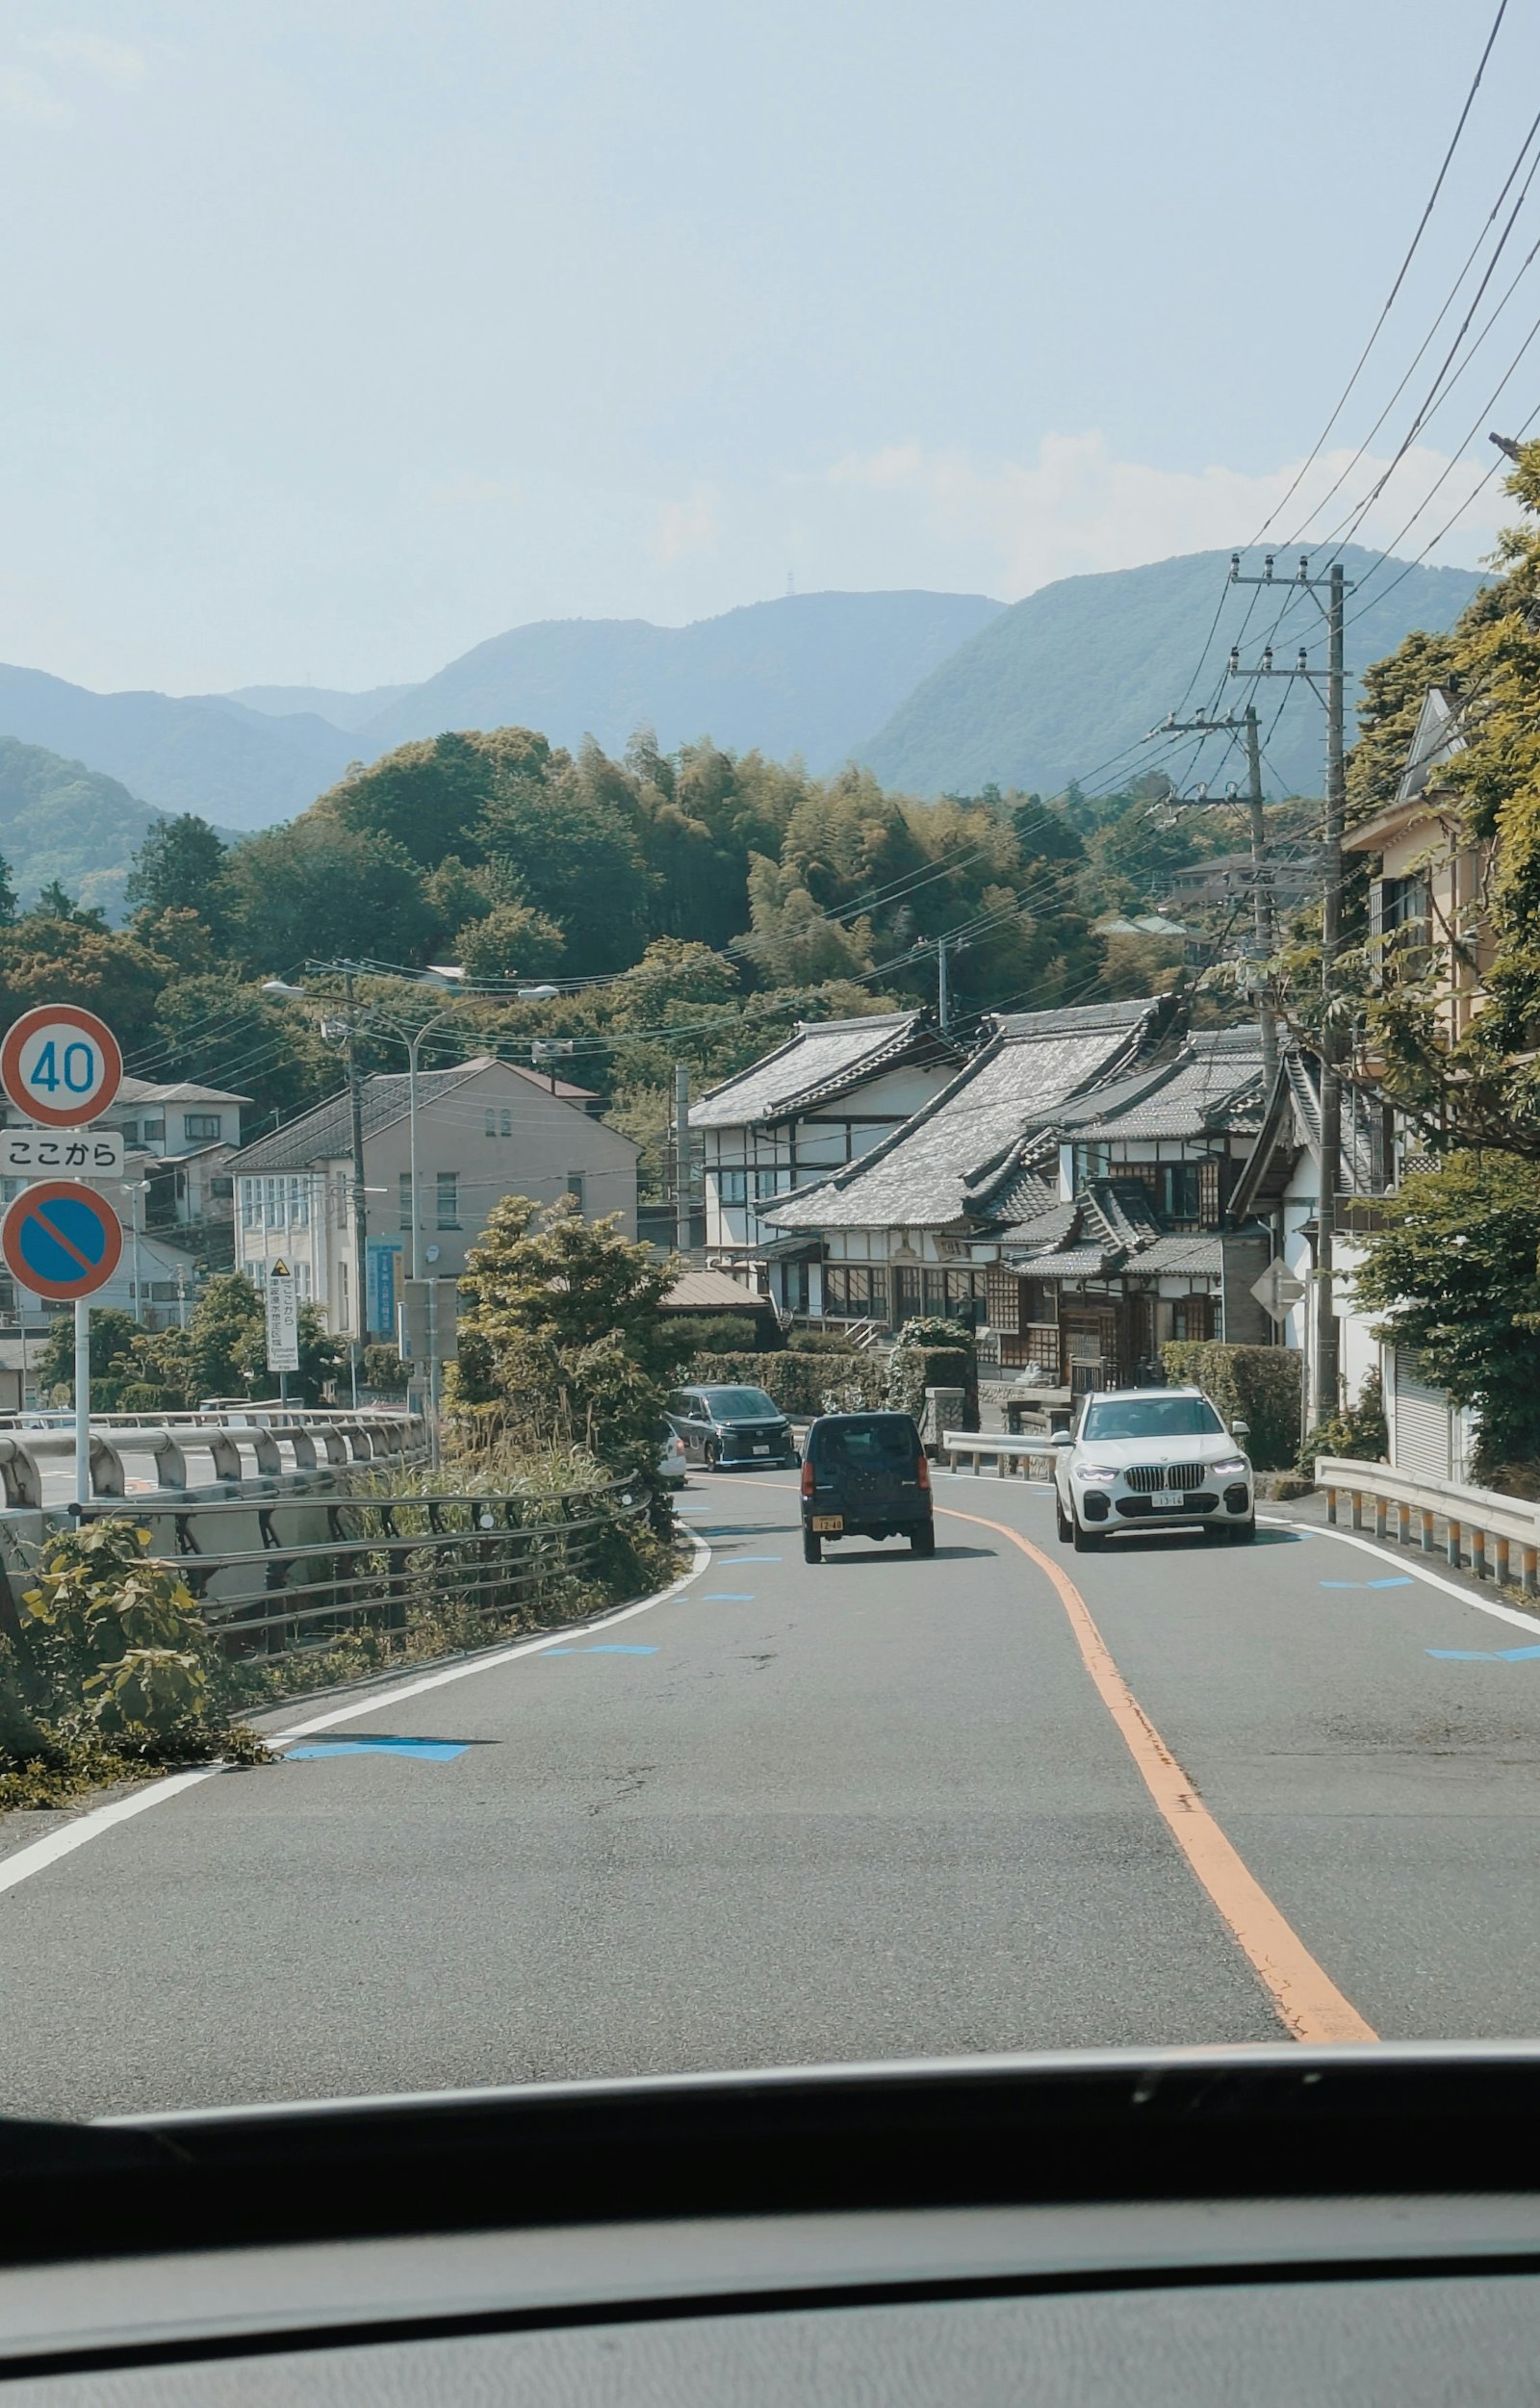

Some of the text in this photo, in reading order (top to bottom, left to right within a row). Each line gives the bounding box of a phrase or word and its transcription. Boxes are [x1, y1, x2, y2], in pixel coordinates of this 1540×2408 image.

[31, 1040, 94, 1093] 40
[10, 1141, 116, 1166] ここから
[283, 1284, 295, 1326] ここから
